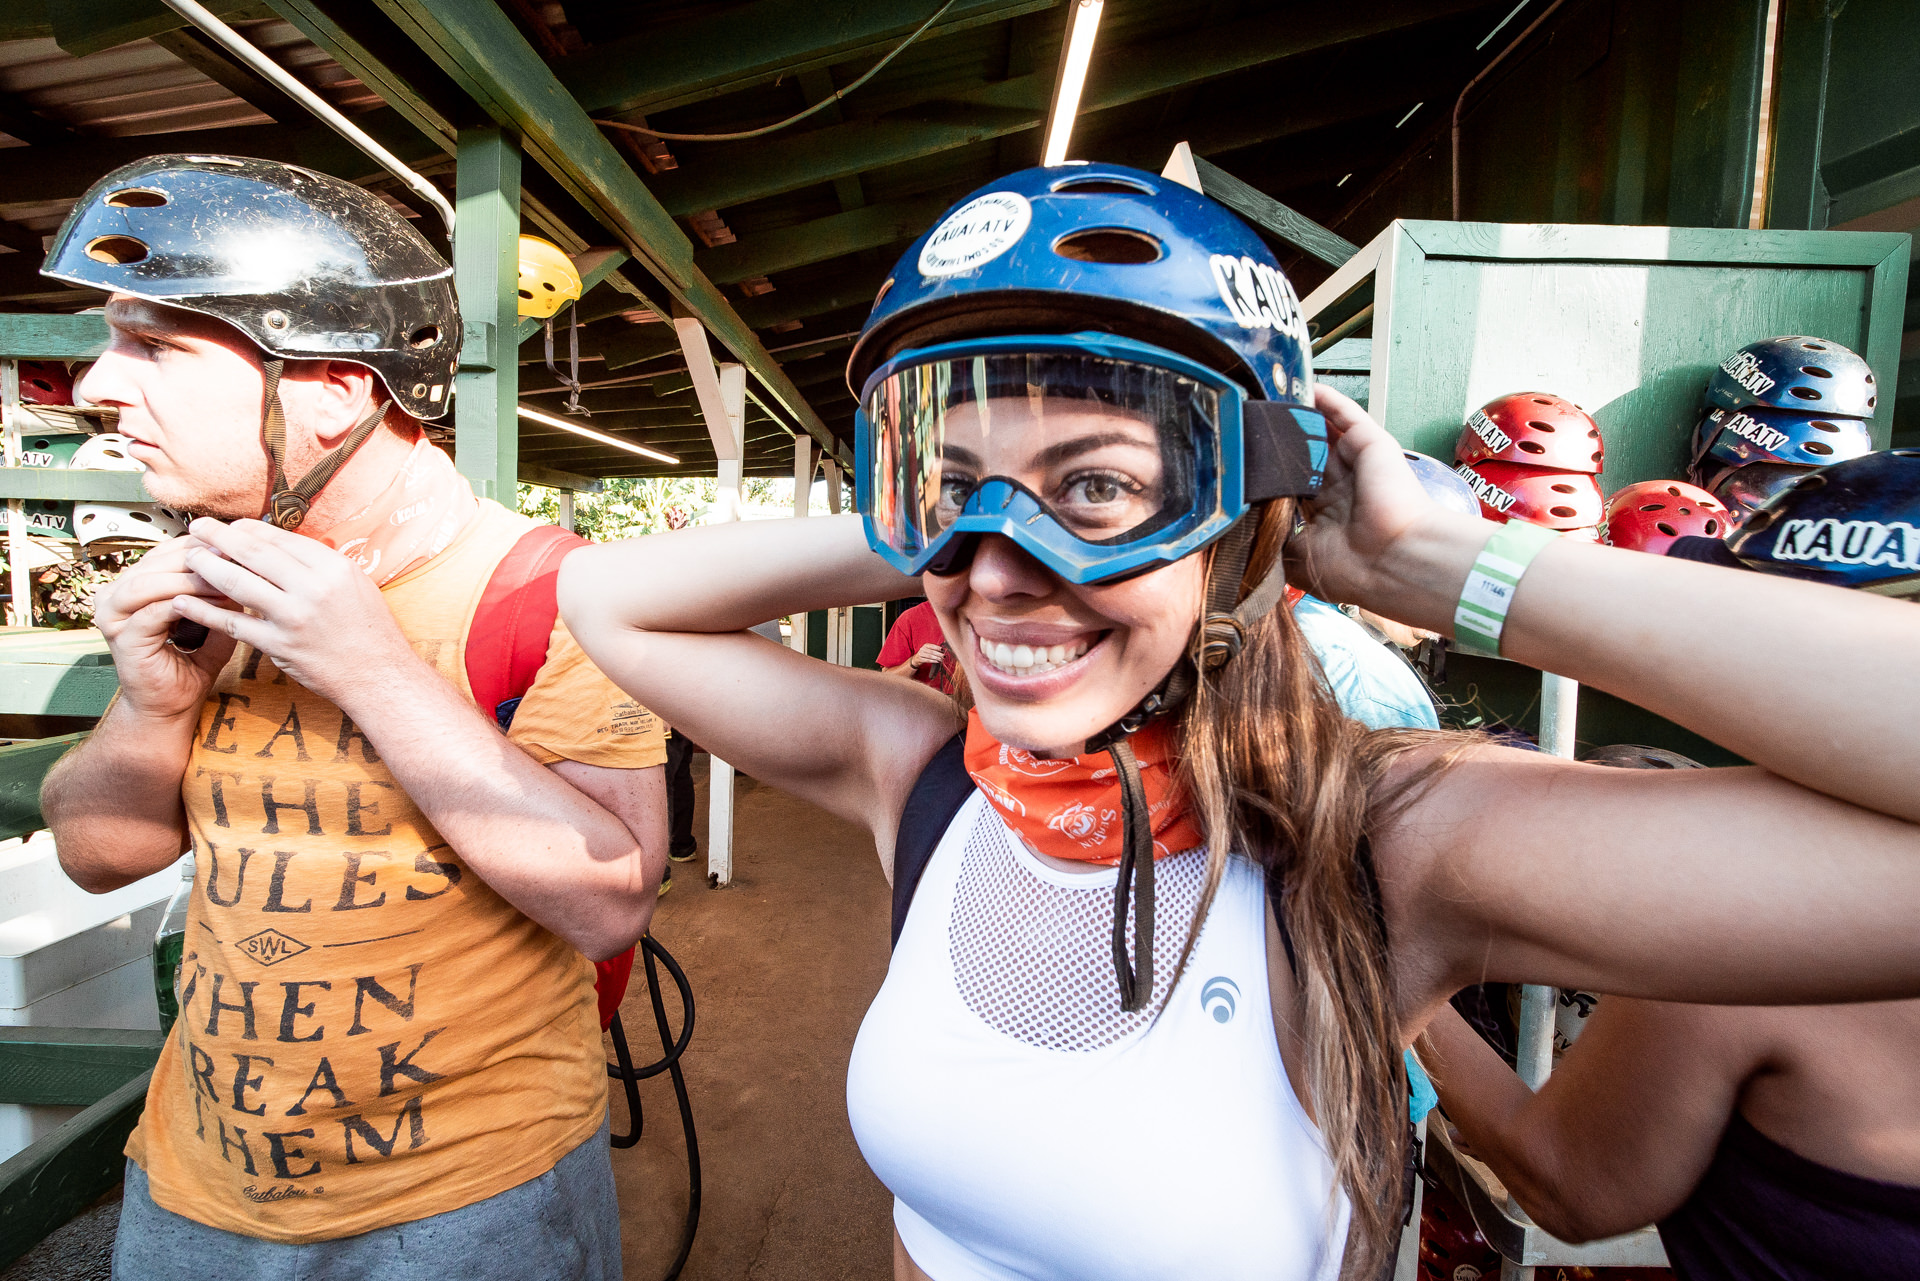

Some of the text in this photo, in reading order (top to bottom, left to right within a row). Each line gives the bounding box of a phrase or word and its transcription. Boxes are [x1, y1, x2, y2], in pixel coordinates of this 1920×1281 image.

[979, 219, 1015, 232] ATV
[1219, 263, 1300, 329] KAUA
[1740, 370, 1772, 393] ATV
[1483, 427, 1510, 451] ATV
[1747, 425, 1786, 449] ATV
[22, 452, 50, 465] ATV
[1481, 485, 1513, 510] ATV
[33, 514, 64, 528] ATV
[1781, 522, 1920, 564] KAUA
[202, 692, 381, 764] EAR
[196, 766, 395, 837] THE
[190, 832, 462, 914] ULES
[247, 936, 292, 956] SWL
[1554, 1029, 1573, 1050] TV
[181, 1026, 448, 1116] REAK
